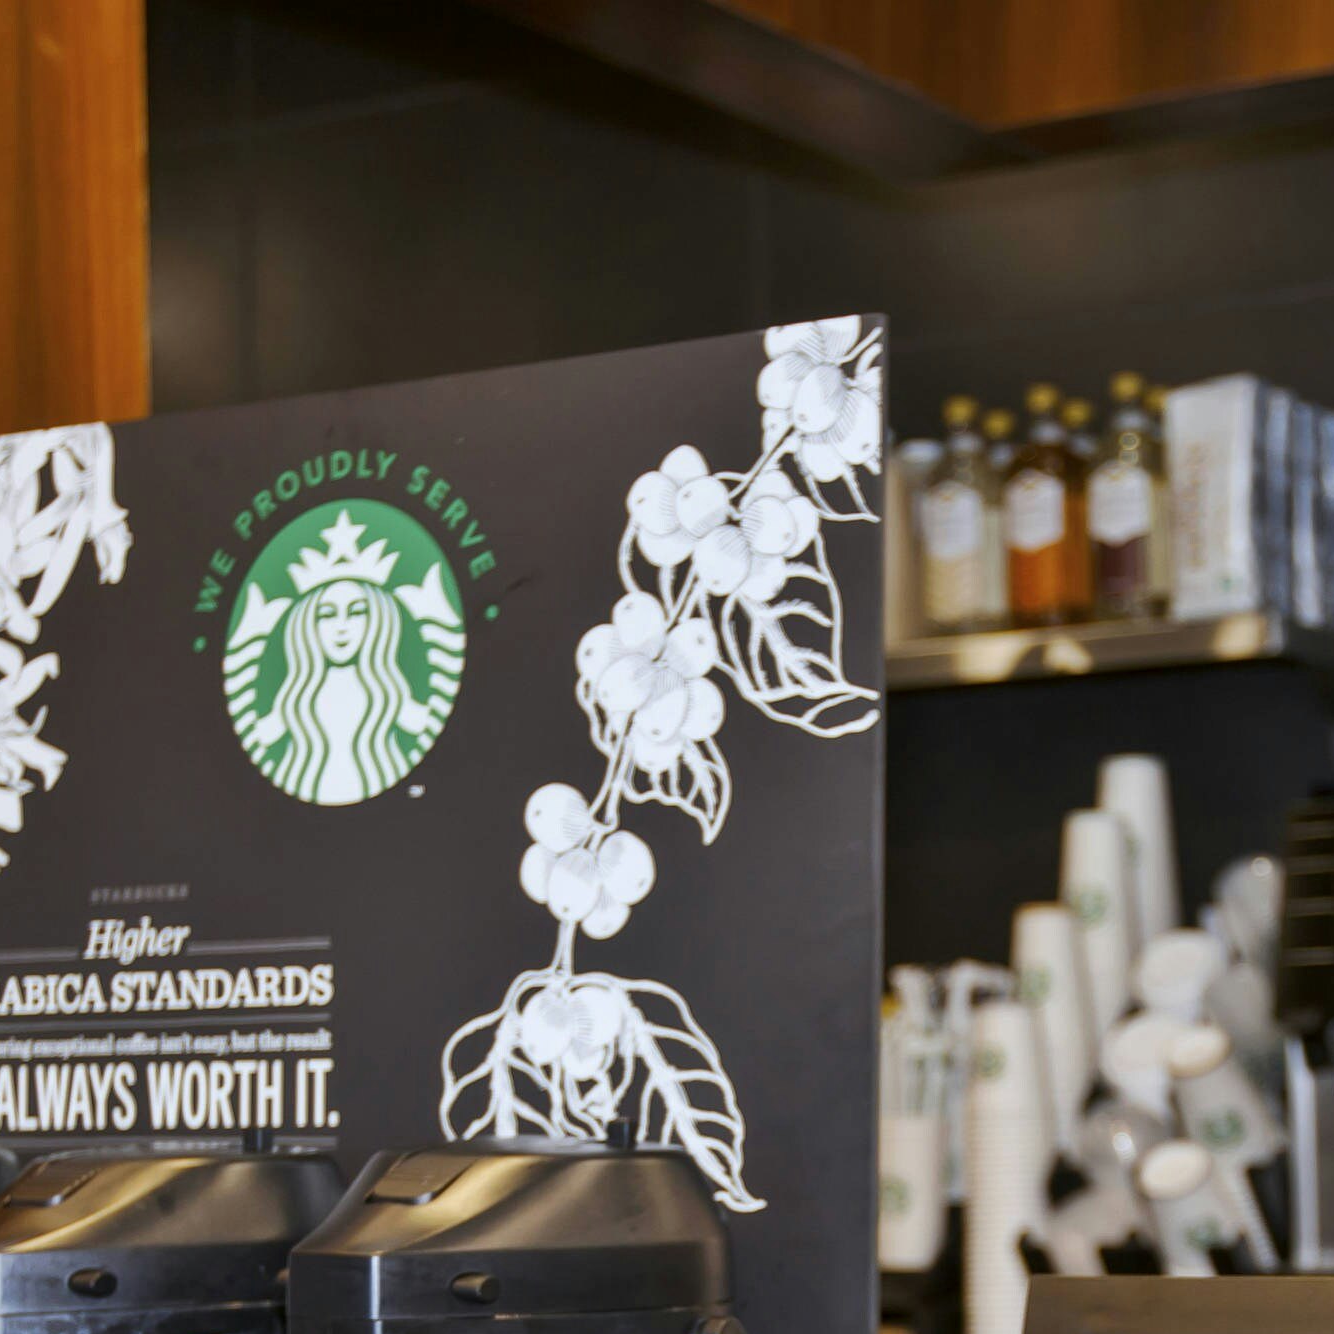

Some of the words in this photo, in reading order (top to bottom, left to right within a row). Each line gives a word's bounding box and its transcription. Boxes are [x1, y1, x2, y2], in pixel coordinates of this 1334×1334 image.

[194, 549, 236, 613] WE
[234, 449, 397, 540] PROUDLY
[407, 465, 496, 580] SERVE
[83, 916, 191, 965] Higher
[110, 964, 334, 1013] STANDARDS
[116, 1031, 158, 1055] coffee
[231, 1029, 256, 1053] but
[259, 1028, 284, 1052] the
[286, 1027, 331, 1051] result
[147, 1059, 284, 1130] WORTH
[295, 1058, 341, 1129] IT.
